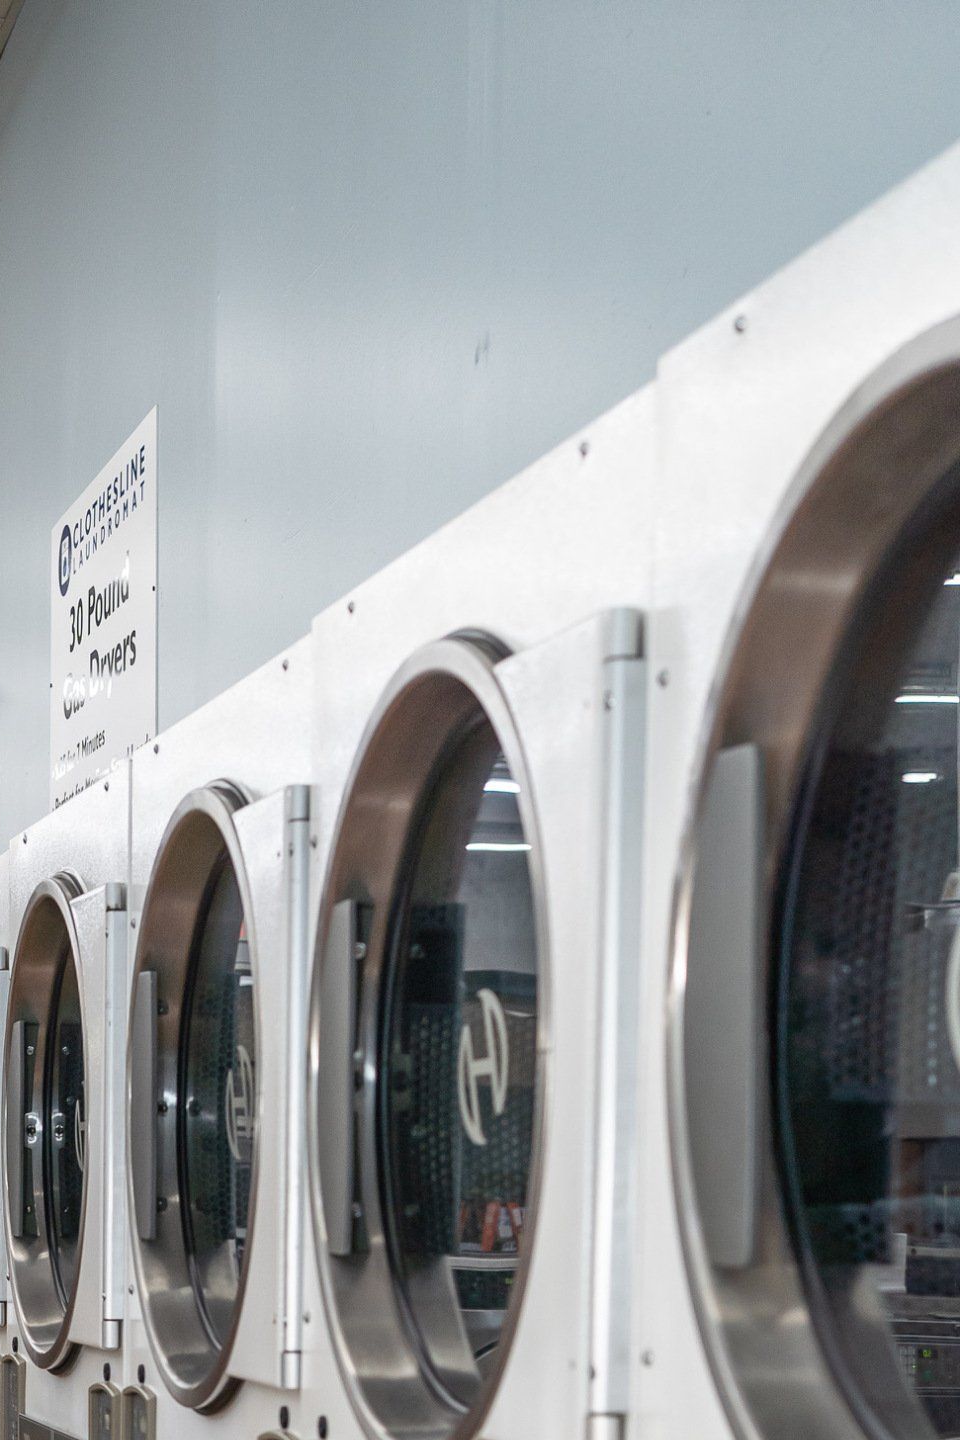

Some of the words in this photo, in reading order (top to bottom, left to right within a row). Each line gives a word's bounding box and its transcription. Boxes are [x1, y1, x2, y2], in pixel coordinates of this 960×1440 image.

[72, 444, 146, 549] CLOTHESLINE
[72, 480, 146, 575] LAUNDROMAT
[69, 597, 84, 653] 30
[87, 550, 130, 636] Pound
[63, 673, 87, 720] Gas
[89, 629, 137, 699] Dryers
[81, 729, 106, 759] Minutes
